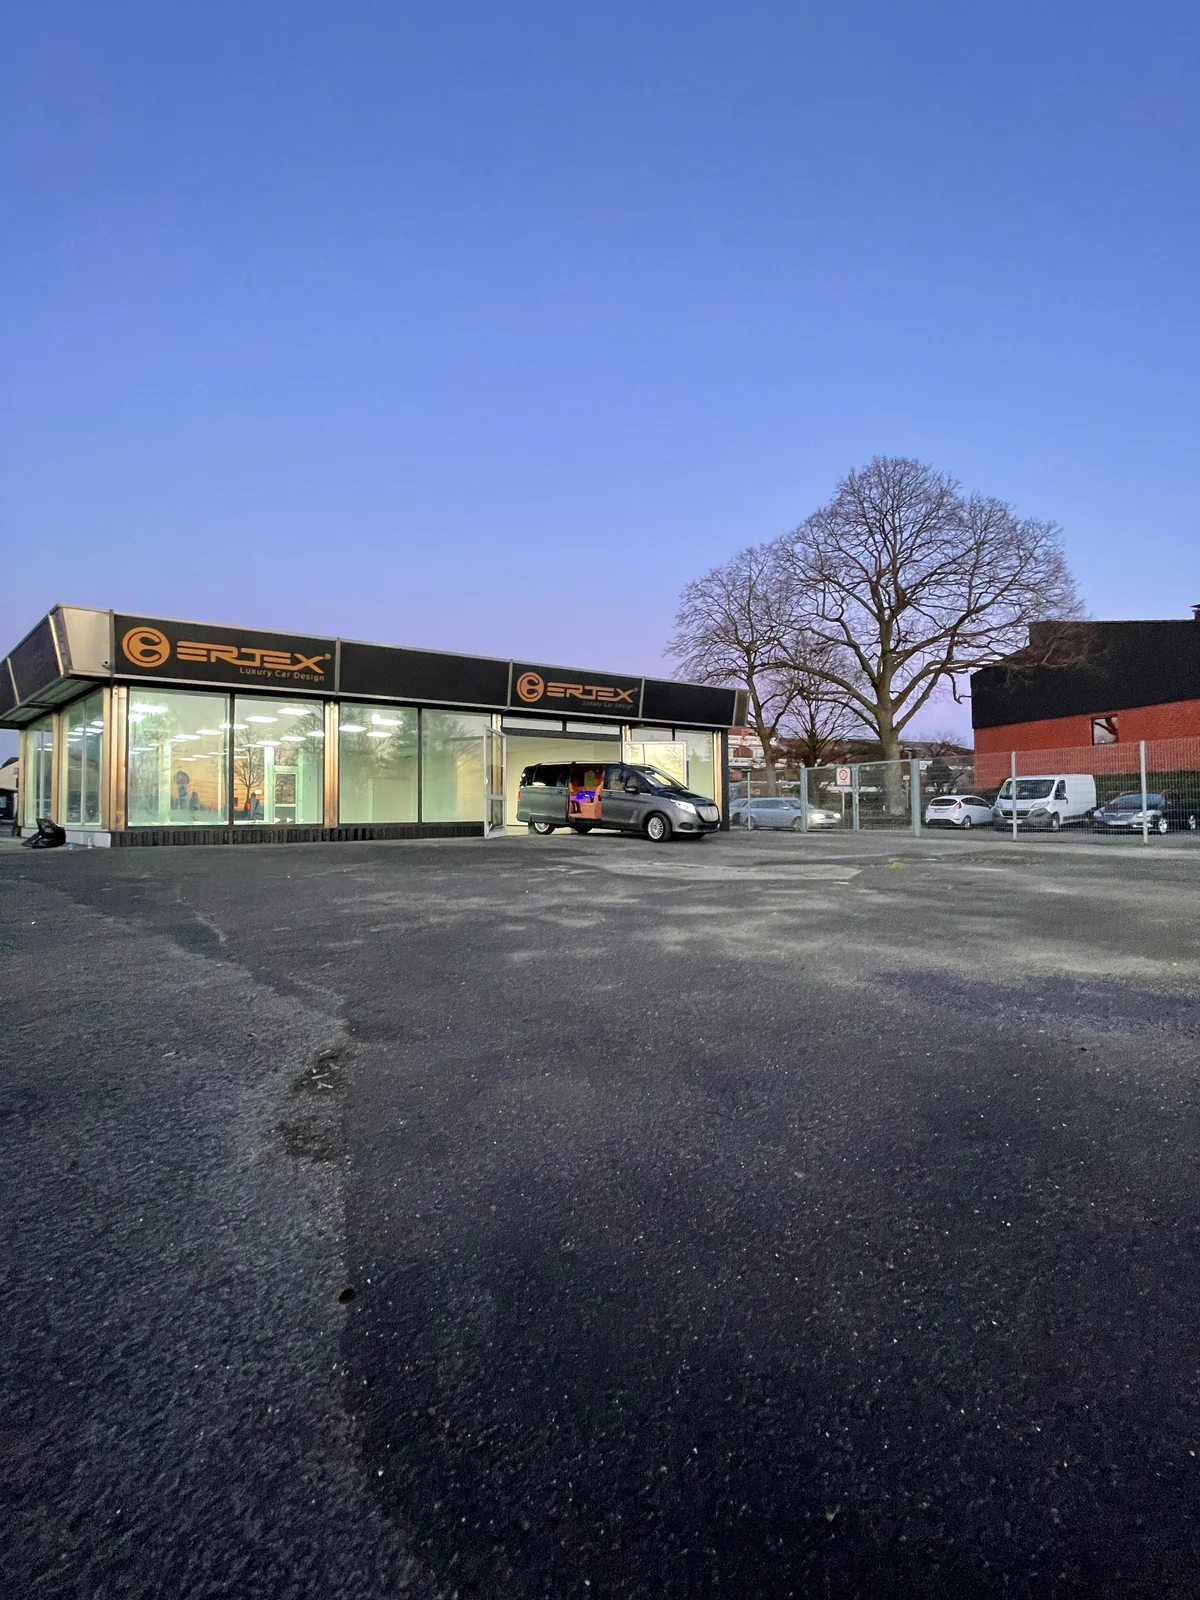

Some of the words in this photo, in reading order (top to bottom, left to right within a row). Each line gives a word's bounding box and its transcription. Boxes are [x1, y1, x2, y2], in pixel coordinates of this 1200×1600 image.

[240, 667, 272, 677] Luxury
[275, 670, 291, 678] Car
[294, 672, 325, 682] Design
